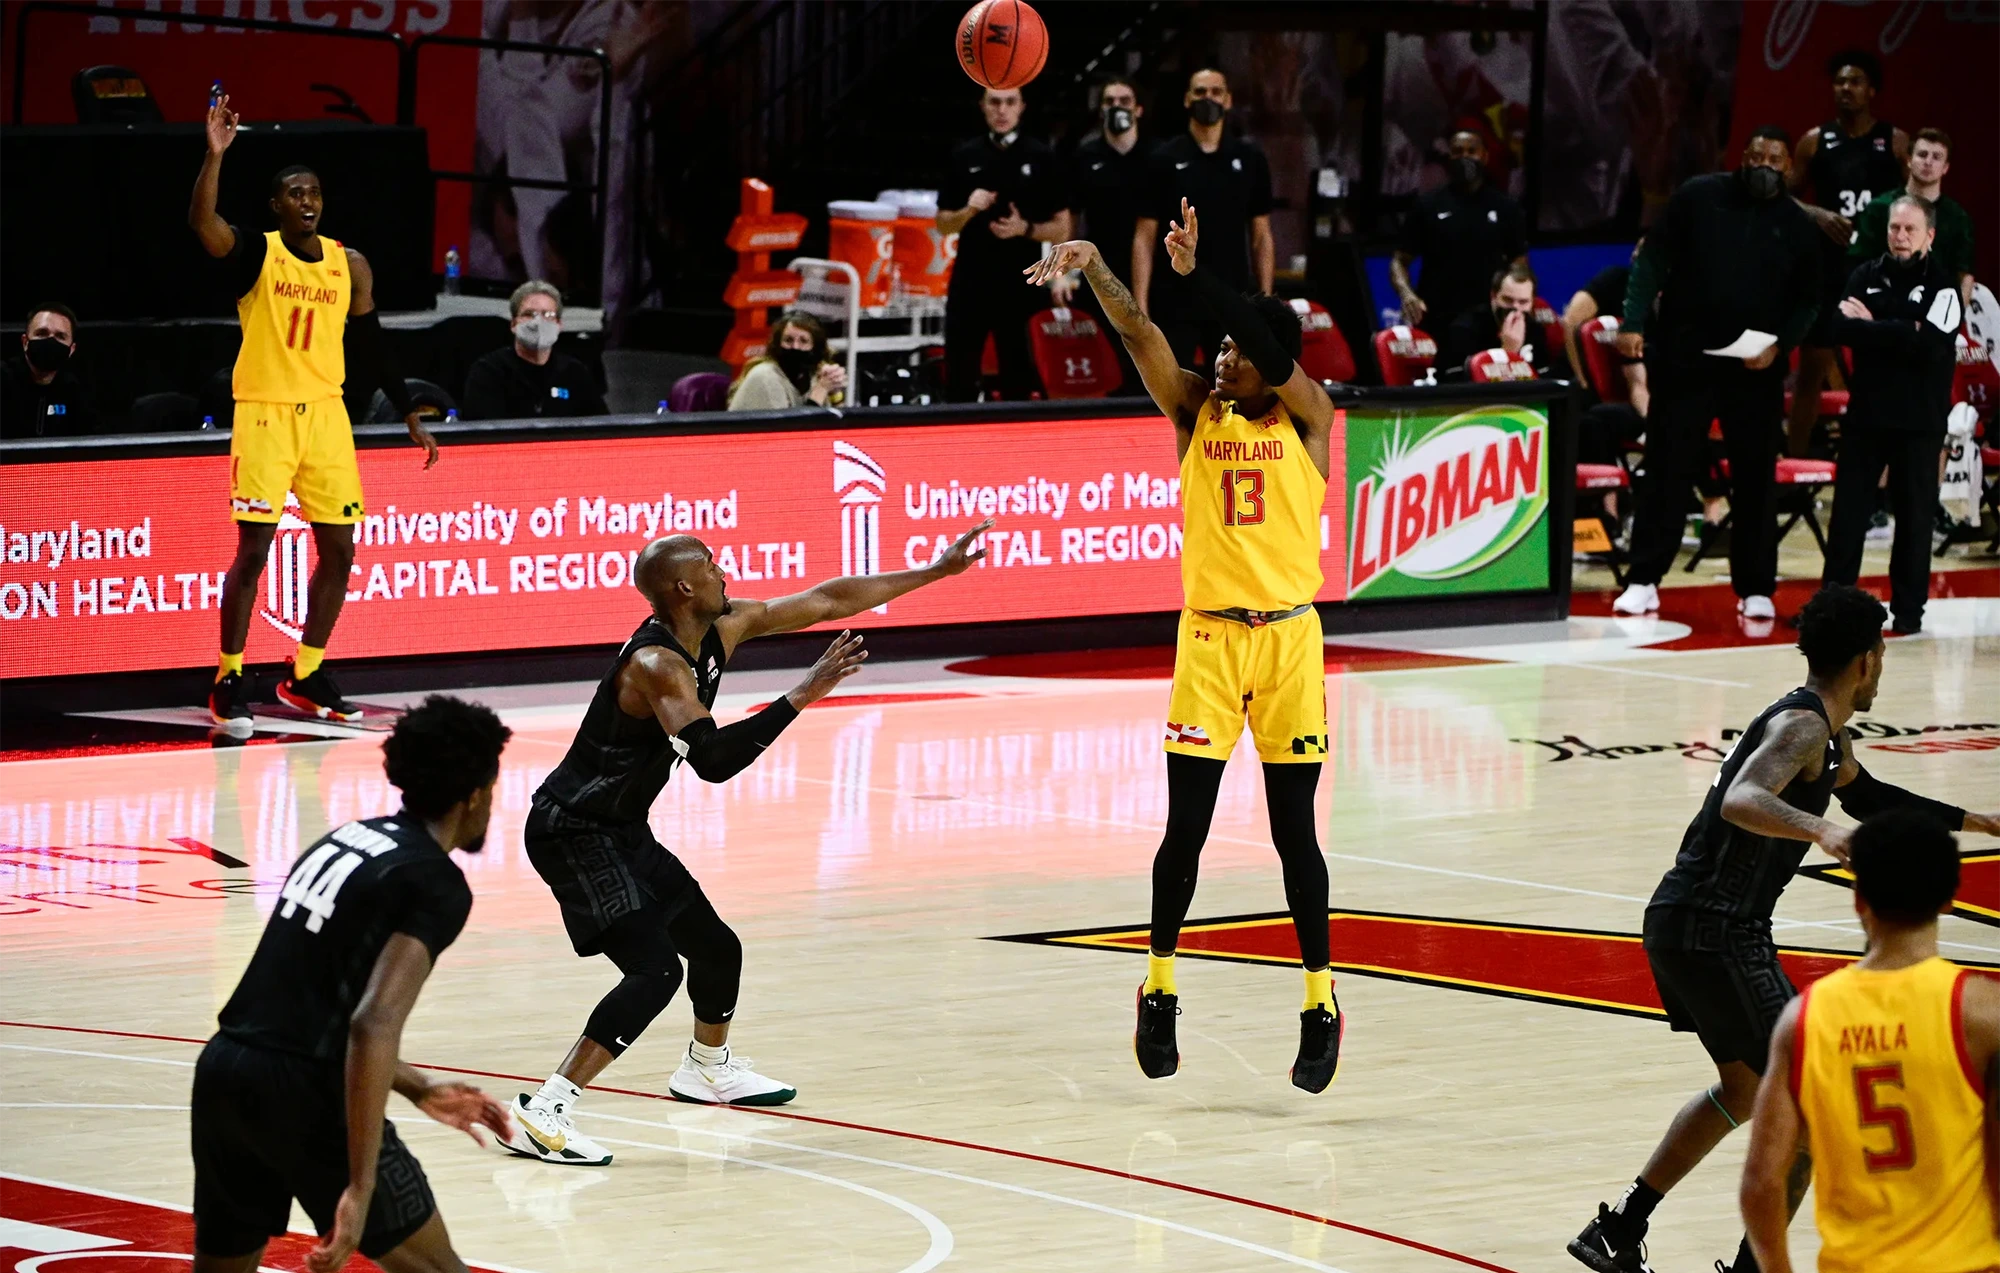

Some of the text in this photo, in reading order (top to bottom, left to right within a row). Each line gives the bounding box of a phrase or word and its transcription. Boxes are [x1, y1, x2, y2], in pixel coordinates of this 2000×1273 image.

[273, 280, 338, 305] MARYLAND
[286, 305, 316, 352] 11
[1202, 439, 1284, 462] MARYLAND
[529, 497, 569, 538] of
[579, 488, 738, 541] Maryland
[904, 475, 1070, 520] University
[1079, 472, 1115, 512] of
[1220, 468, 1266, 526] 13
[1349, 428, 1542, 592] LIBMAN
[0, 516, 151, 570] aryland
[73, 571, 226, 617] HEALTH
[279, 842, 365, 935] 44
[1839, 1021, 1909, 1056] AYALA
[1851, 1059, 1918, 1175] 5
